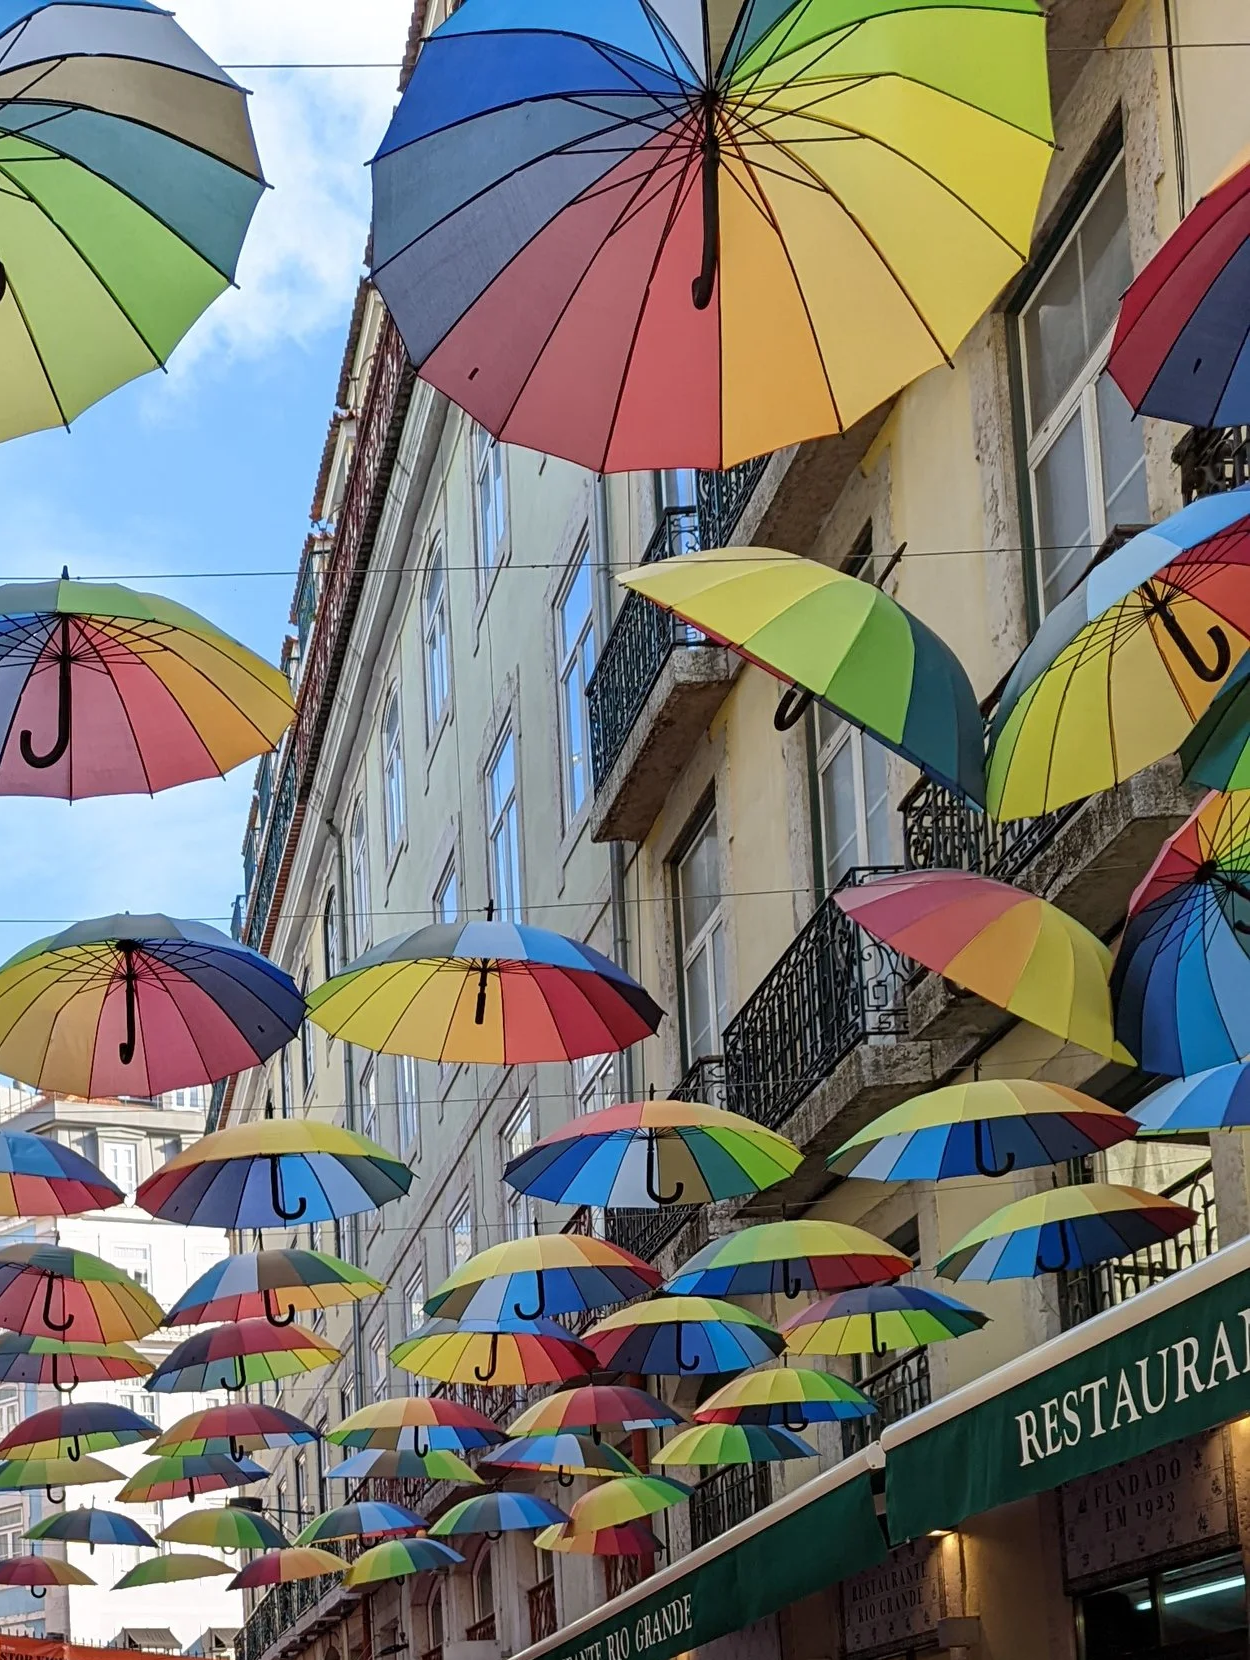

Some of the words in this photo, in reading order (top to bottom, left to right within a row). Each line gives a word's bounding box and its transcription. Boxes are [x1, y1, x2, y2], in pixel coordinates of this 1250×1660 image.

[1095, 1458, 1180, 1508] FUNDADO
[1105, 1506, 1126, 1532] EM
[1136, 1491, 1175, 1520] 1923
[853, 1560, 927, 1601] RESTAURANTE
[635, 1593, 693, 1653] GRANDE
[859, 1603, 875, 1623] RIO
[881, 1587, 923, 1615] GRANDE
